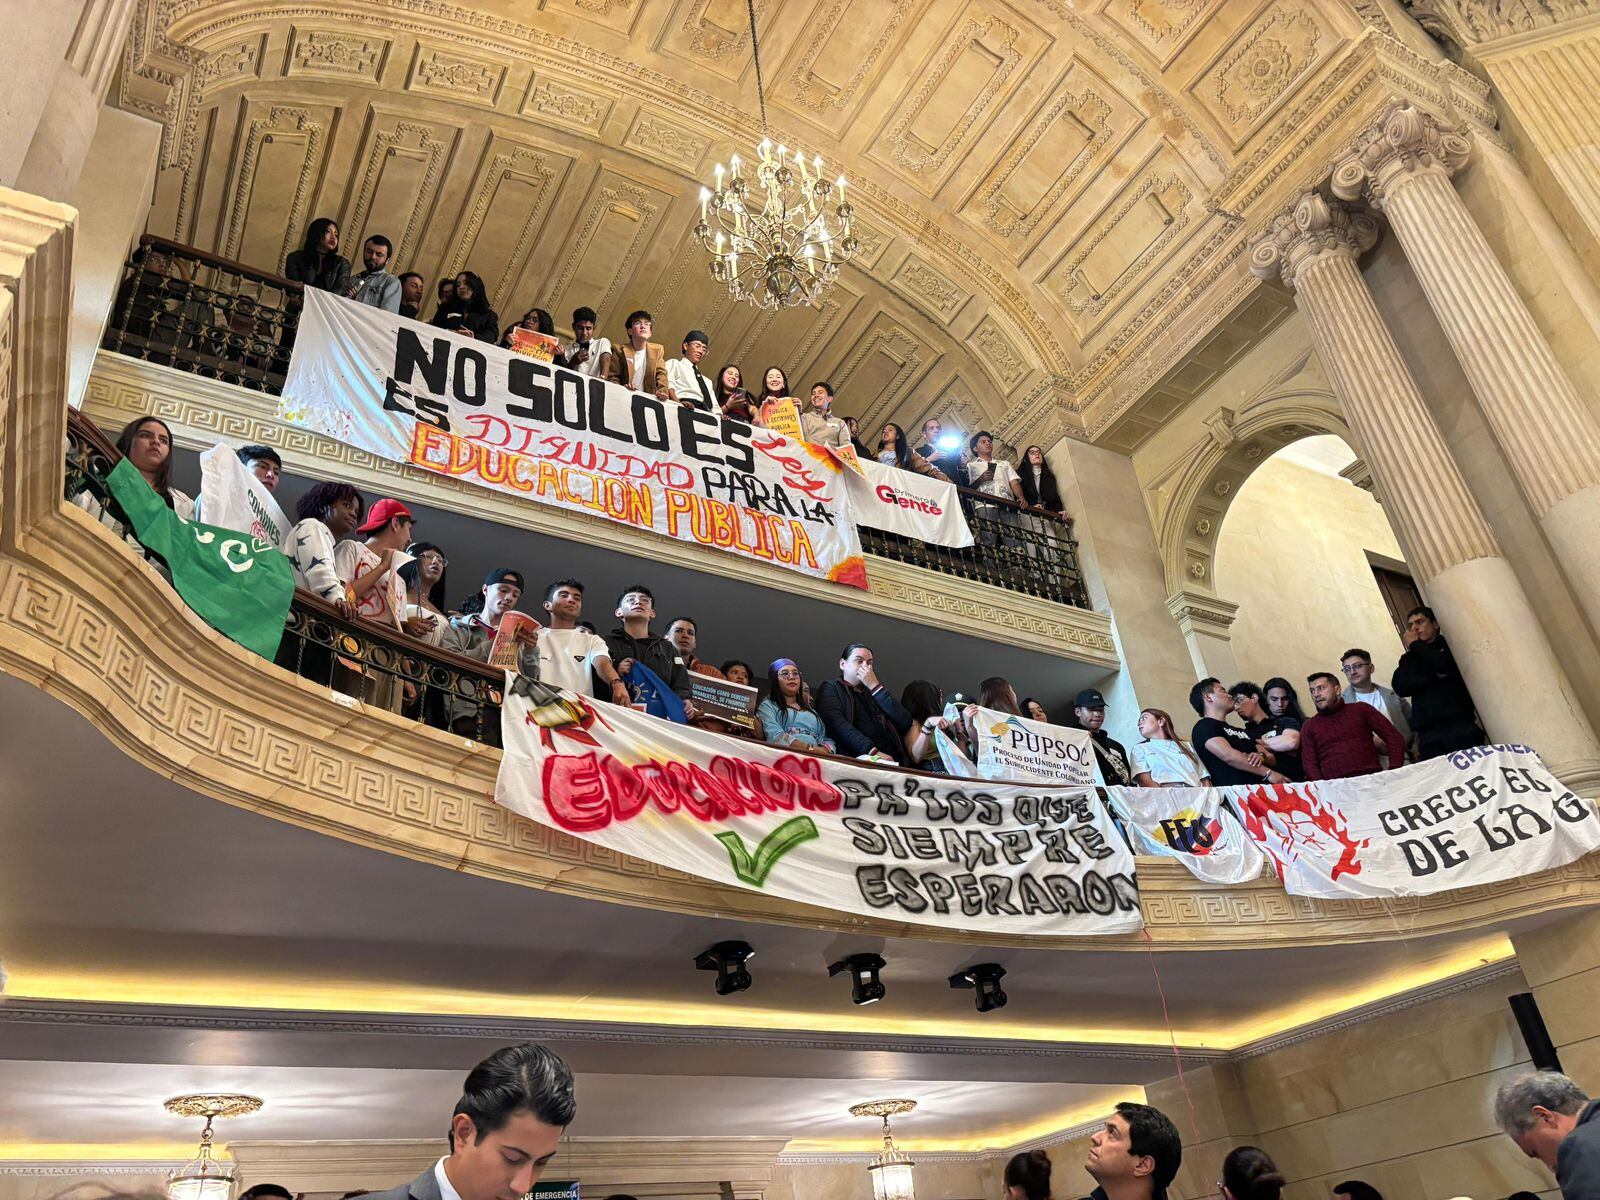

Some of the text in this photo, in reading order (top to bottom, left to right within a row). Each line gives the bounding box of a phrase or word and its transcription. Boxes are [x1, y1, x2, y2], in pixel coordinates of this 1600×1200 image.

[395, 327, 487, 406] NO
[506, 358, 670, 452] SOLO
[676, 406, 756, 474] ES
[383, 377, 451, 432] ES
[701, 466, 800, 517] PARA
[800, 499, 835, 527] LA
[410, 421, 819, 570] EDUCACION PUBLICA
[876, 485, 942, 515] Gente
[894, 488, 929, 504] primero
[1010, 729, 1090, 767] PUPSOC
[1013, 793, 1095, 828] QUE
[1378, 766, 1552, 837] CRECE EL
[843, 817, 1115, 872] SIEMPRE
[1397, 830, 1468, 877] DE
[1473, 803, 1553, 852] LA
[856, 864, 1140, 917] ESPERARON
[535, 1190, 577, 1200] EMERGENCIA
